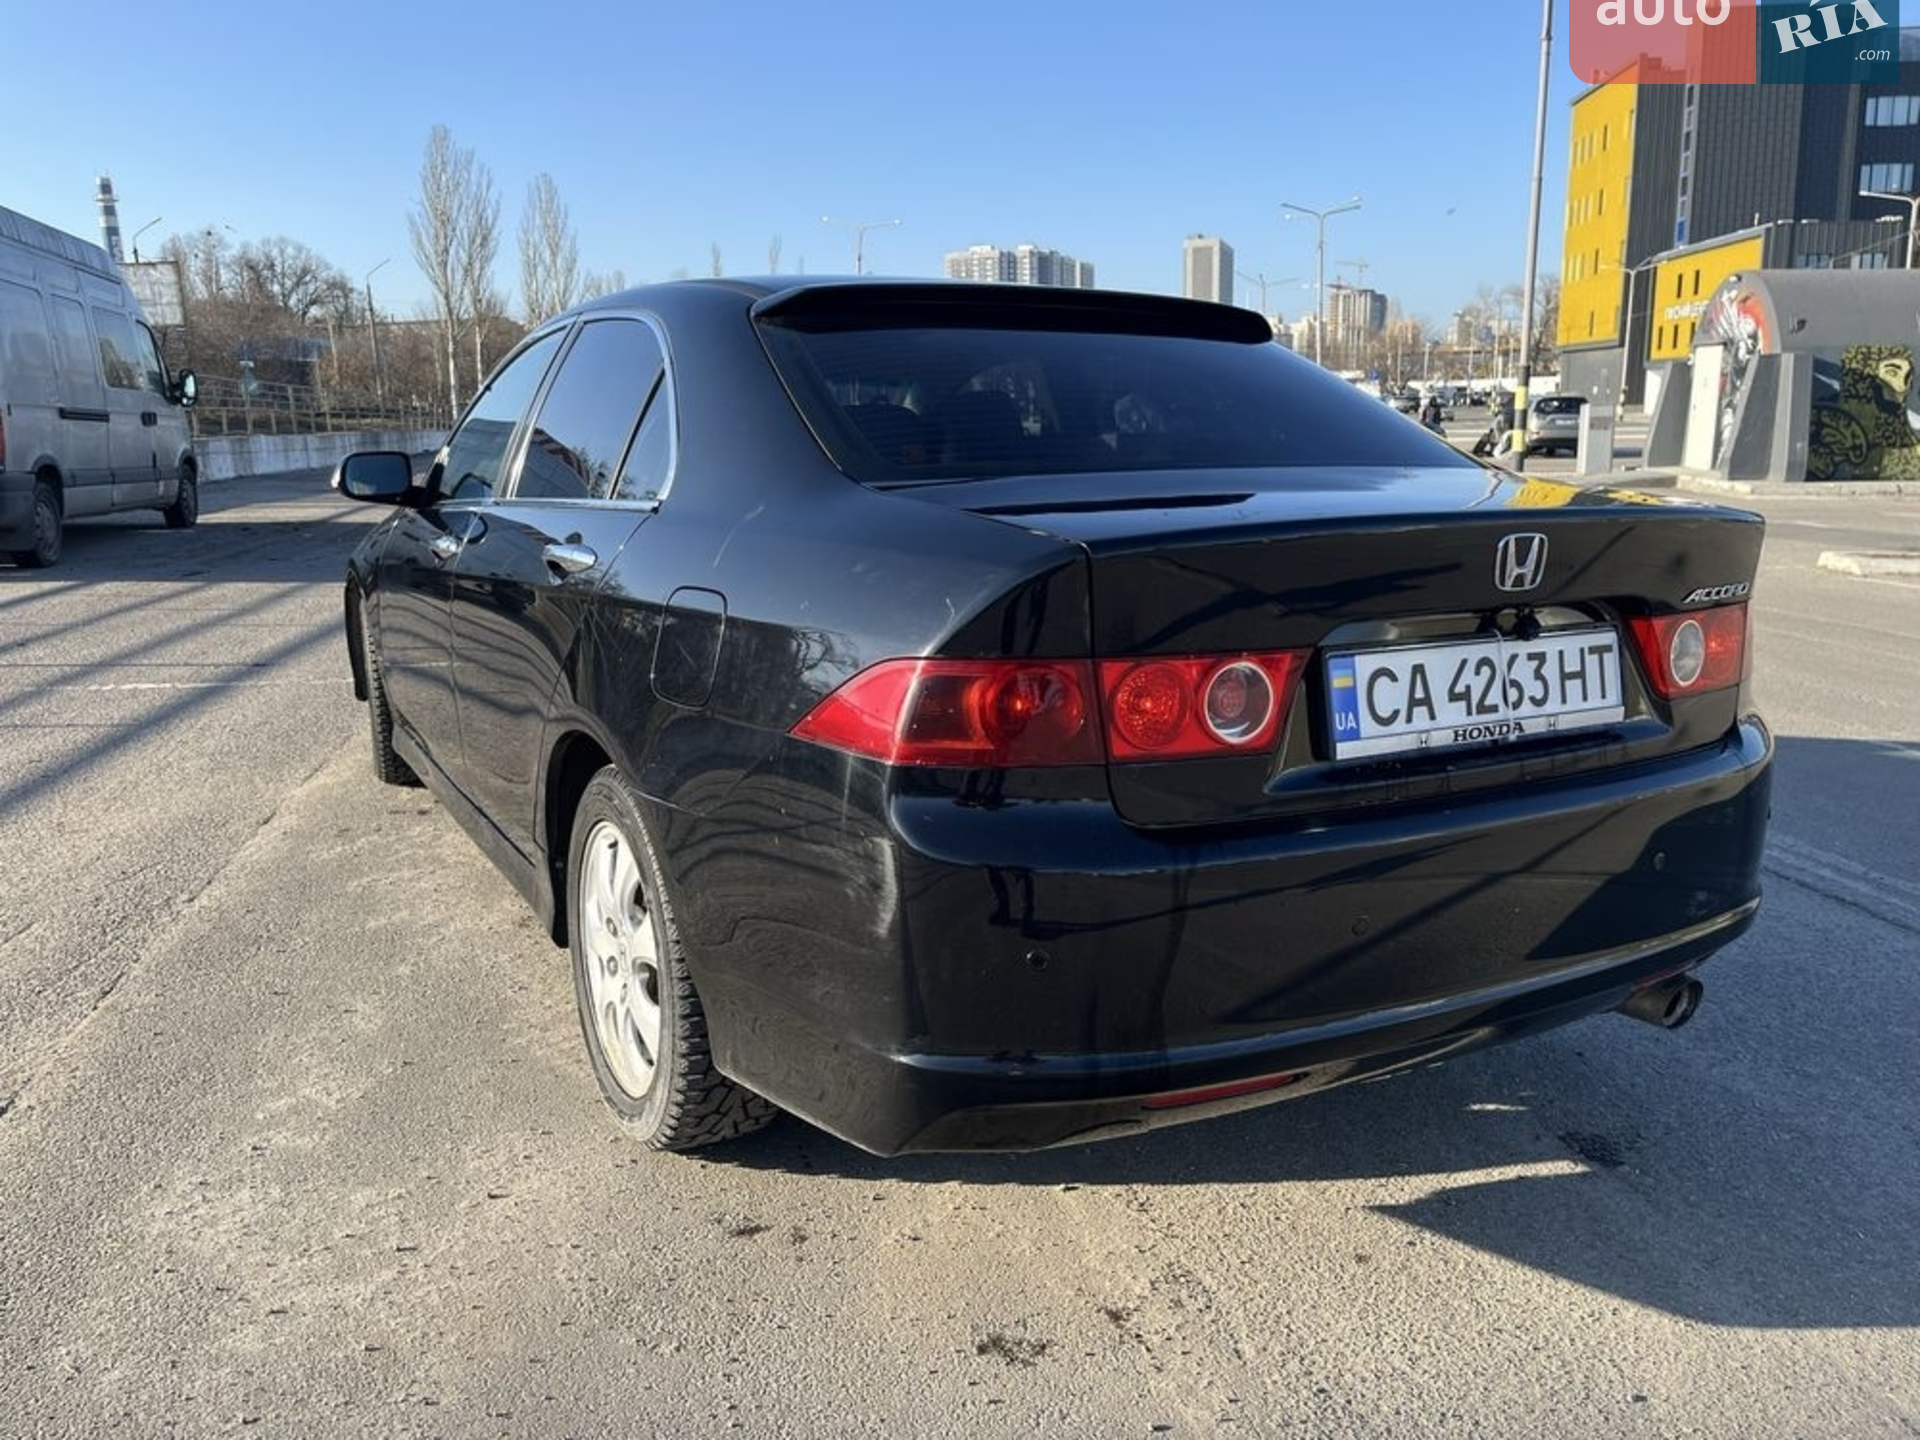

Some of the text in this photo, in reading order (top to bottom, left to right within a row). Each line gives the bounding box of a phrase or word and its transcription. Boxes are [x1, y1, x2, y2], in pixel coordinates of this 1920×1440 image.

[1366, 644, 1613, 728] CA 4263 HT
[1335, 711, 1358, 731] UA
[1453, 721, 1525, 743] HONDA
